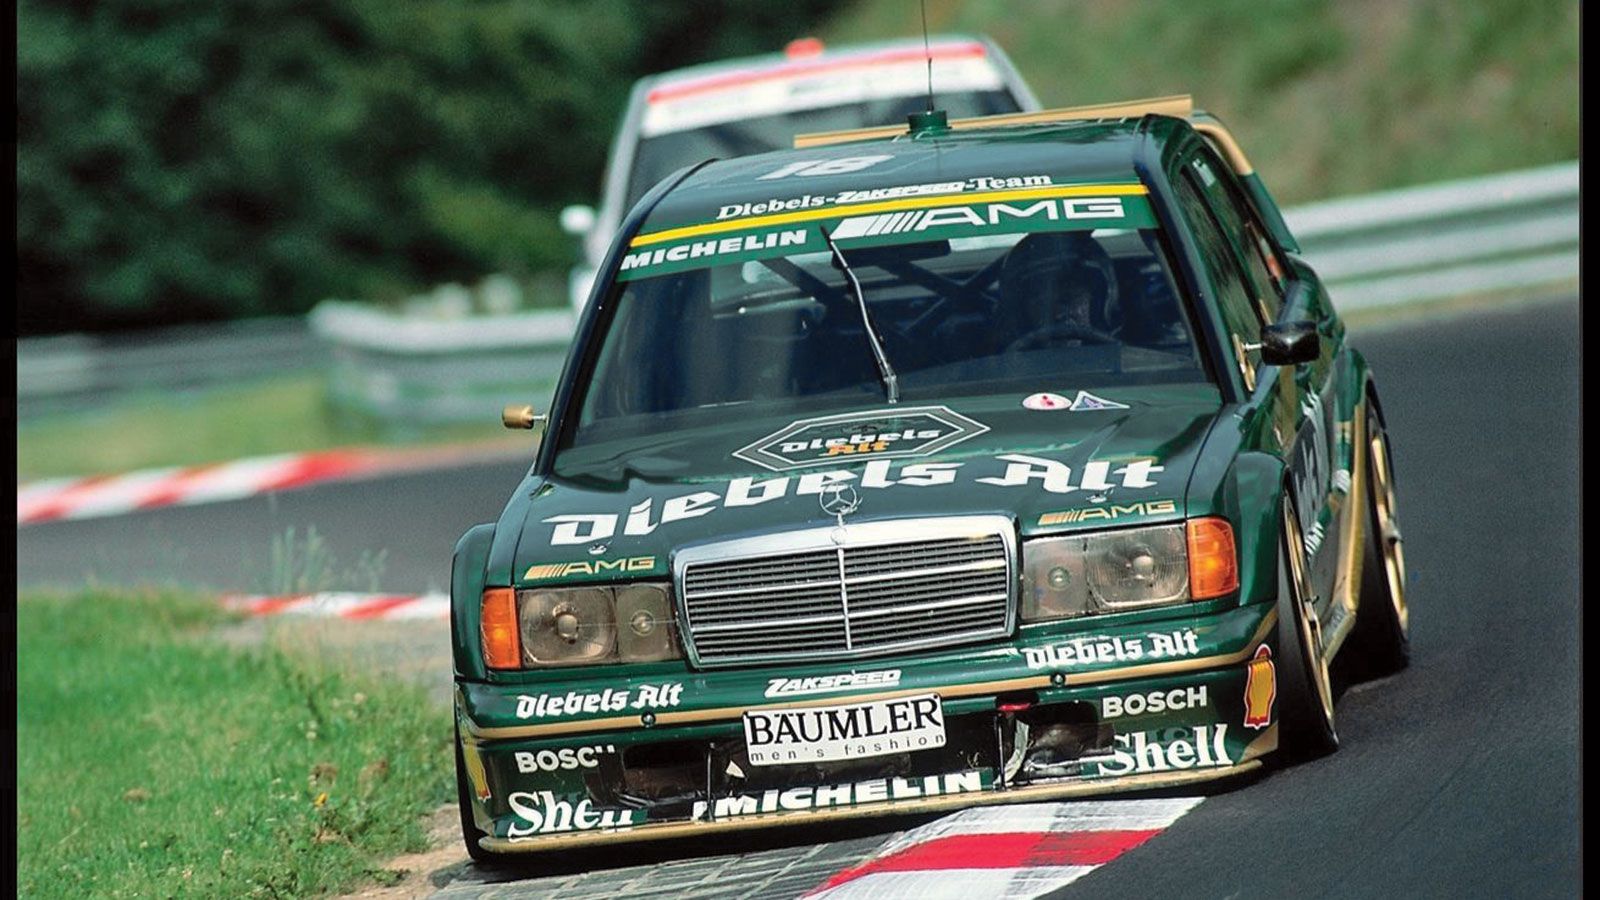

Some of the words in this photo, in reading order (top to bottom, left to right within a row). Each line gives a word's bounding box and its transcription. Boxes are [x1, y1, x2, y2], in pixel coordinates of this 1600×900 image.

[915, 197, 1124, 232] AMG
[620, 229, 807, 271] MICHELIN
[541, 460, 964, 545] Diebels
[975, 454, 1164, 493] Alt
[1078, 500, 1176, 521] AMG
[563, 556, 655, 575] AMG
[764, 669, 902, 698] ZAKSPEED
[1103, 685, 1208, 718] BOSCH
[749, 697, 941, 746] BÄUMLER
[515, 744, 616, 773] BOSC
[750, 745, 825, 762] men's
[844, 734, 946, 757] fashion
[1097, 723, 1234, 777] Shell
[714, 770, 983, 817] MICHELIN
